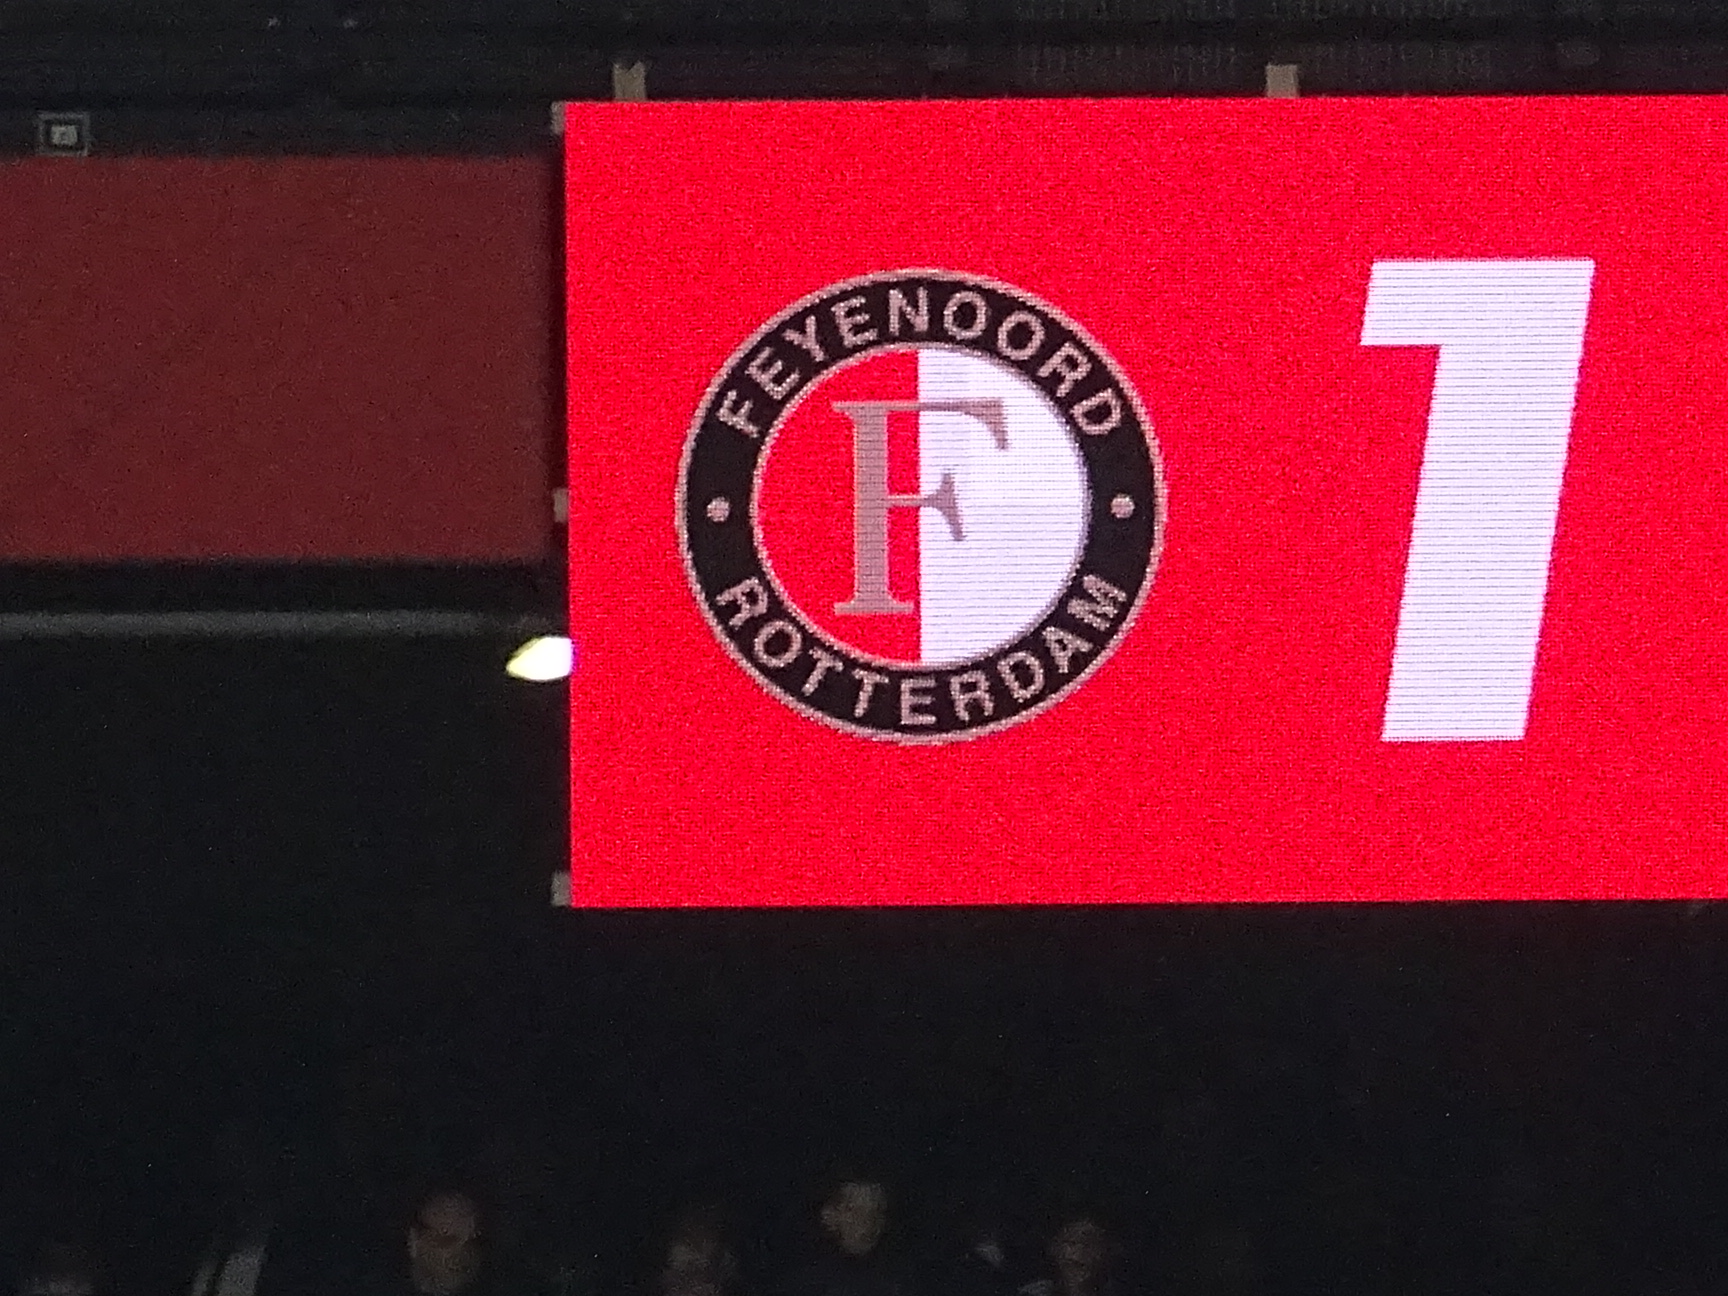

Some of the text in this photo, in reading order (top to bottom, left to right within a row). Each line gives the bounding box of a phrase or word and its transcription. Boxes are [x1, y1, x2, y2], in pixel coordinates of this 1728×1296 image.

[718, 287, 1122, 438] FEYENOORD
[832, 396, 1010, 616] F
[1359, 257, 1597, 742] 1
[717, 575, 1127, 726] ROTTERDAM
